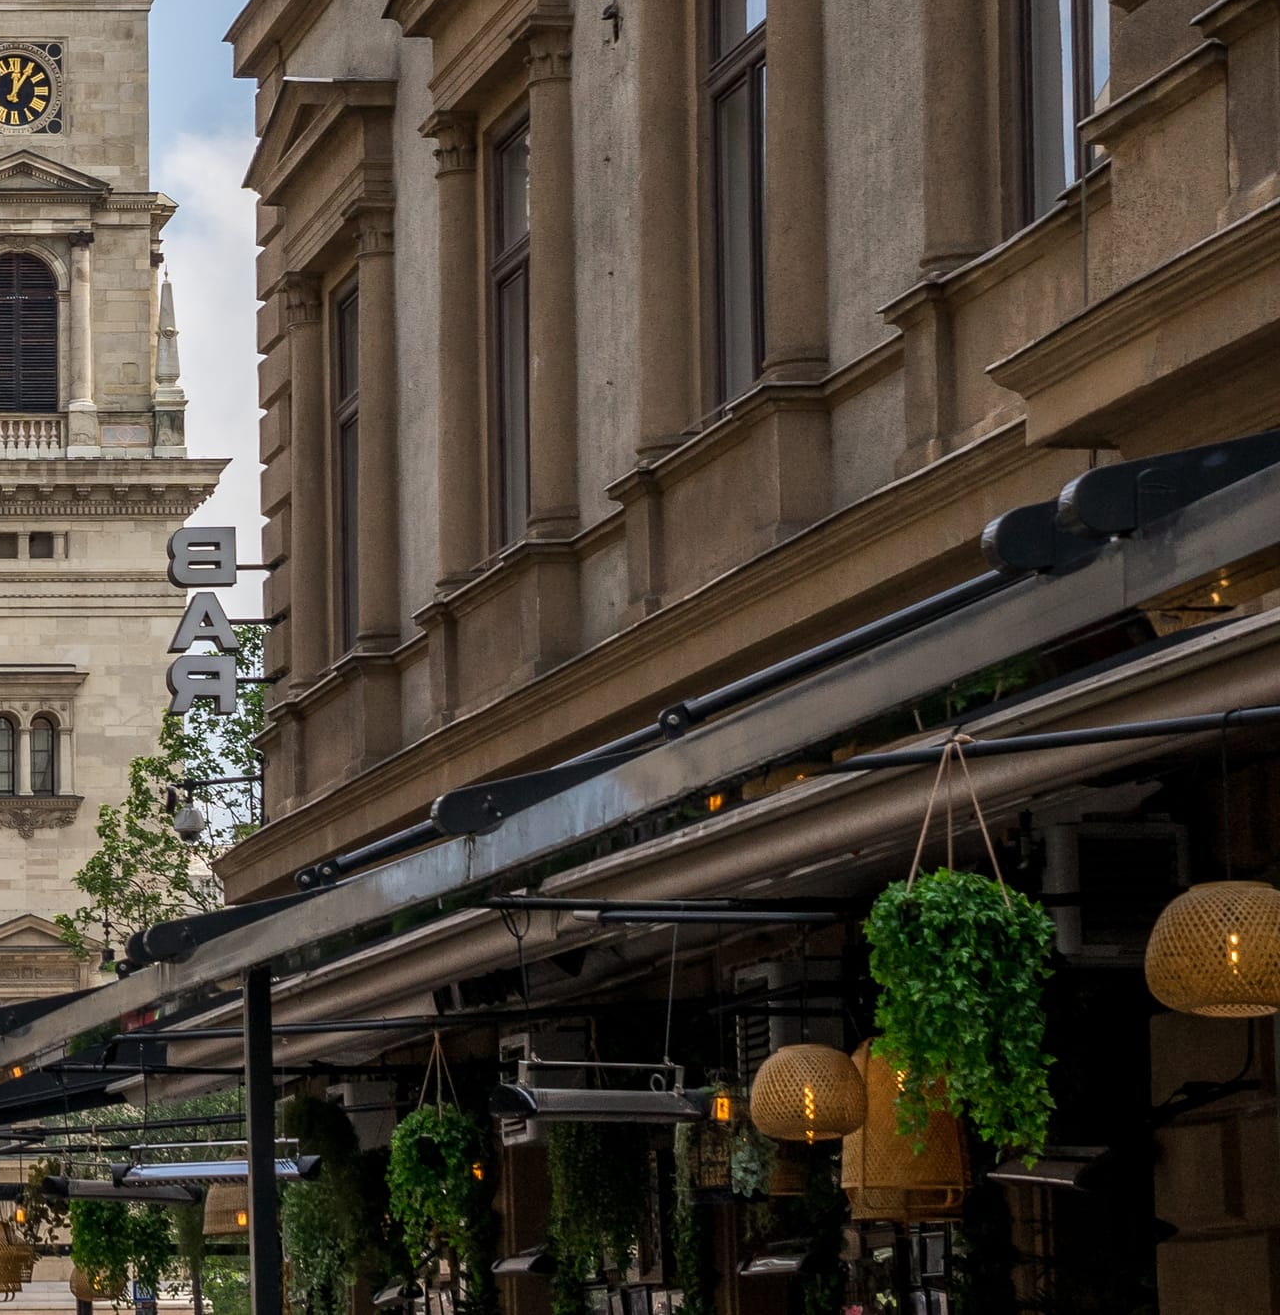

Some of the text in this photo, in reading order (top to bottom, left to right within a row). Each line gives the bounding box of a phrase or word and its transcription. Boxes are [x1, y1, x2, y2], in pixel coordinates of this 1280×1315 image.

[30, 72, 45, 84] II
[34, 87, 48, 96] III
[24, 108, 34, 121] V
